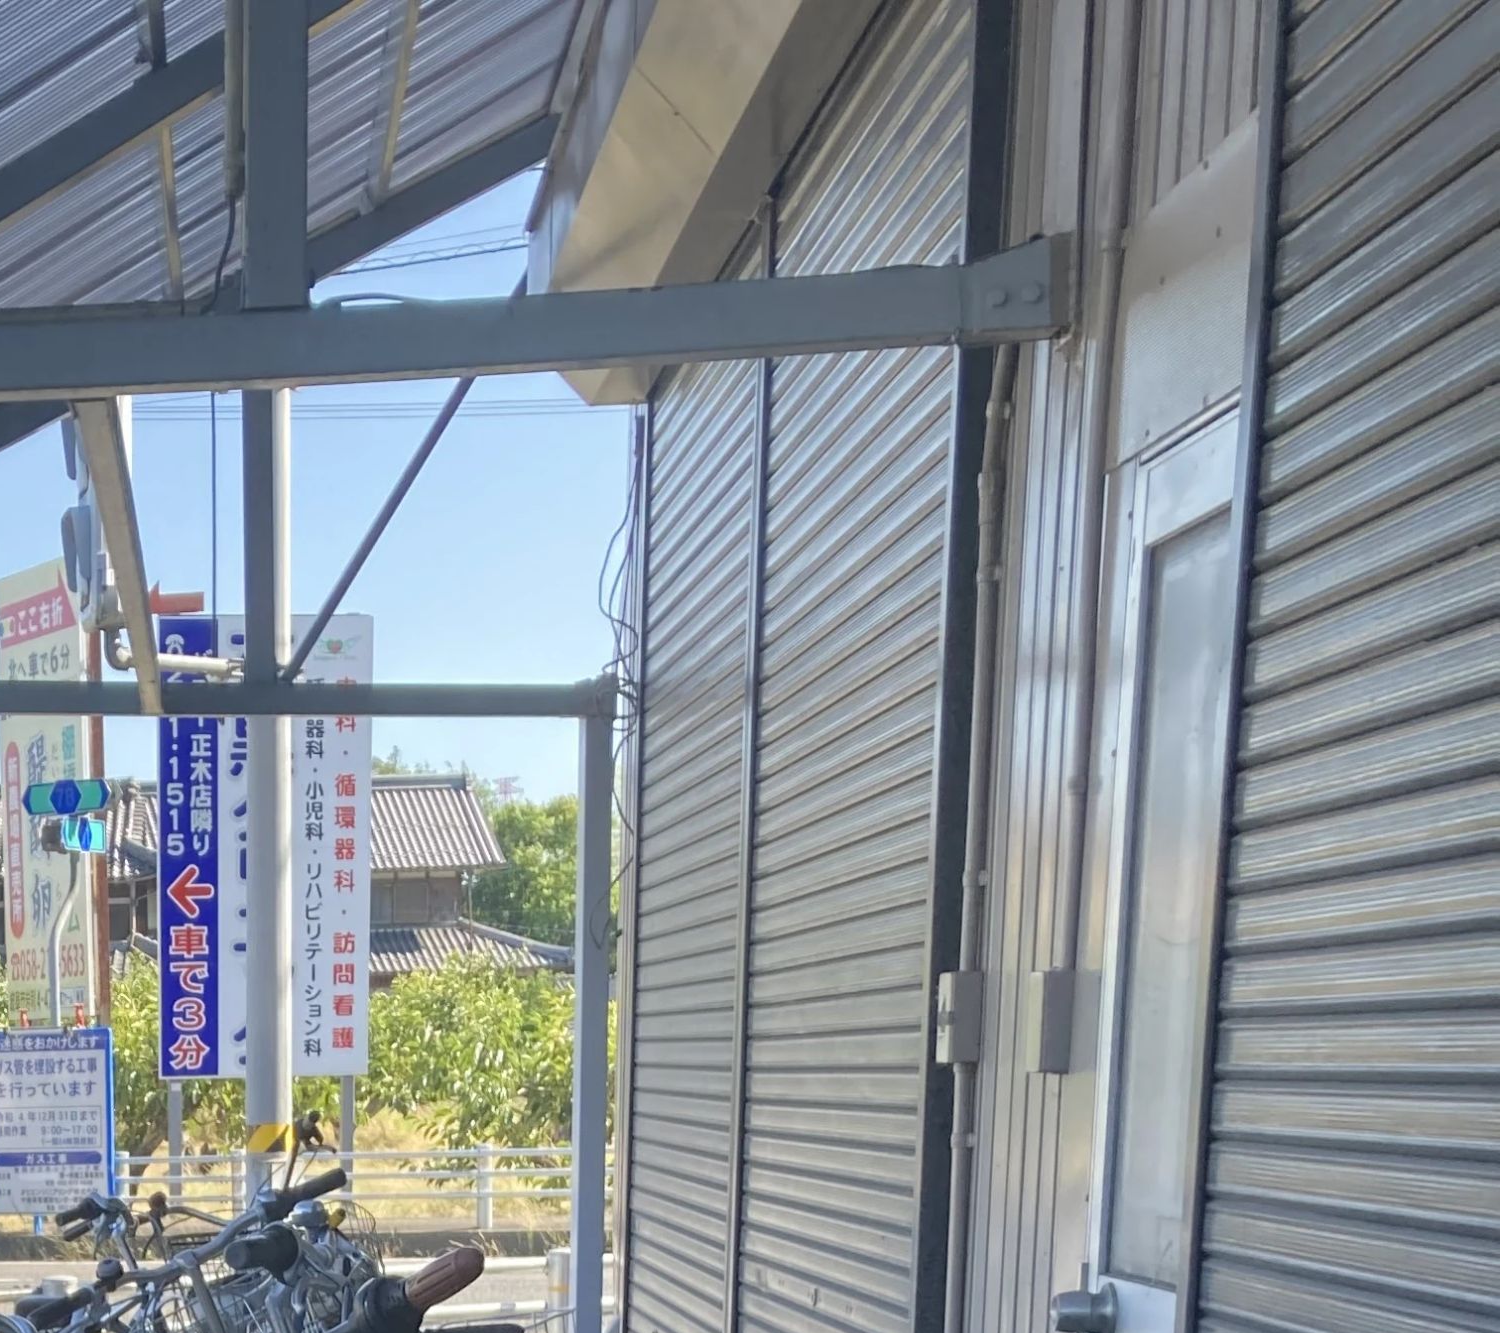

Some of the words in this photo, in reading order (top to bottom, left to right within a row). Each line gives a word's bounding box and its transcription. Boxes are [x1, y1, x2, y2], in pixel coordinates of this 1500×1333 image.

[18, 595, 63, 636] ここ右折
[20, 944, 85, 981] 058-2-5633
[169, 923, 210, 1070] 車で3分
[26, 1153, 67, 1165] ガス工事
